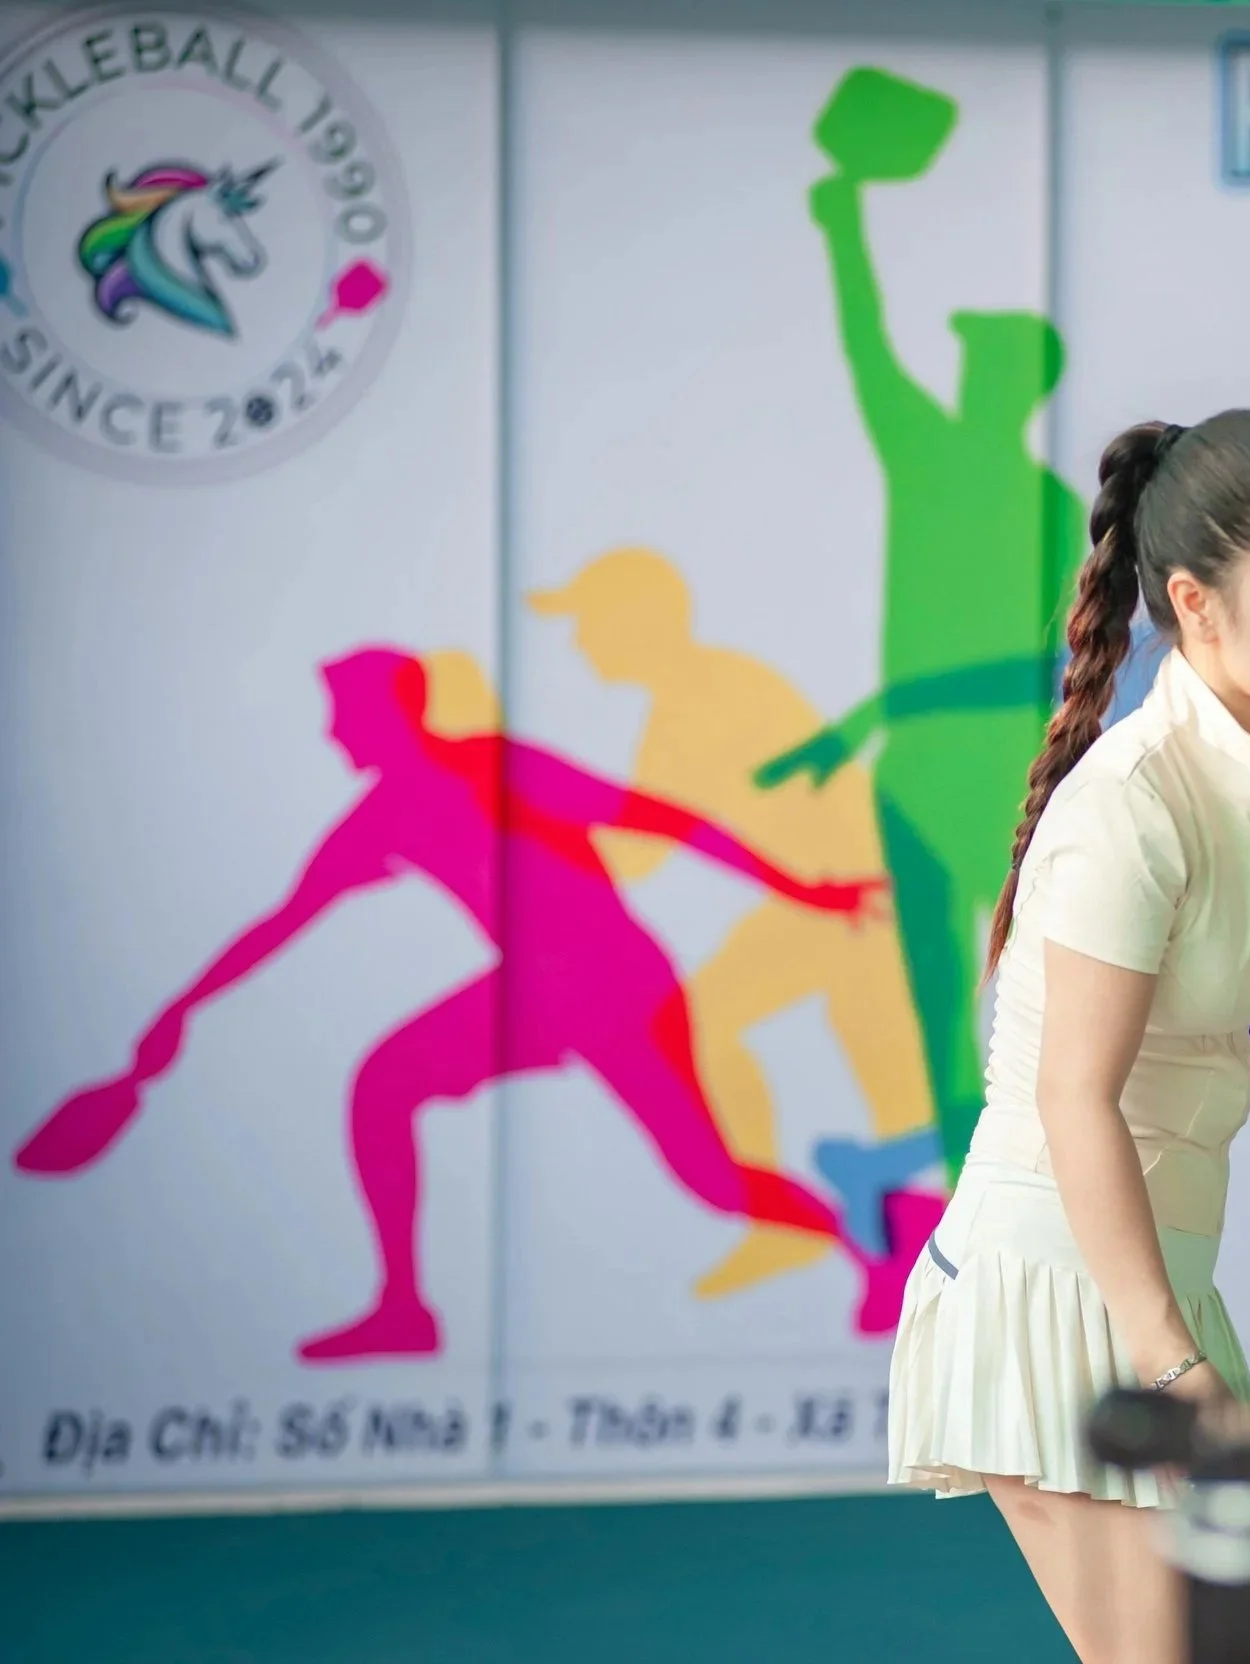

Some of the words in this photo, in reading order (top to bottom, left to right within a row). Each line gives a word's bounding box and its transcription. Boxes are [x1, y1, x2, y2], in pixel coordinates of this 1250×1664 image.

[297, 94, 388, 245] 1990
[0, 326, 184, 452] SINCE
[43, 1410, 132, 1477] Địa
